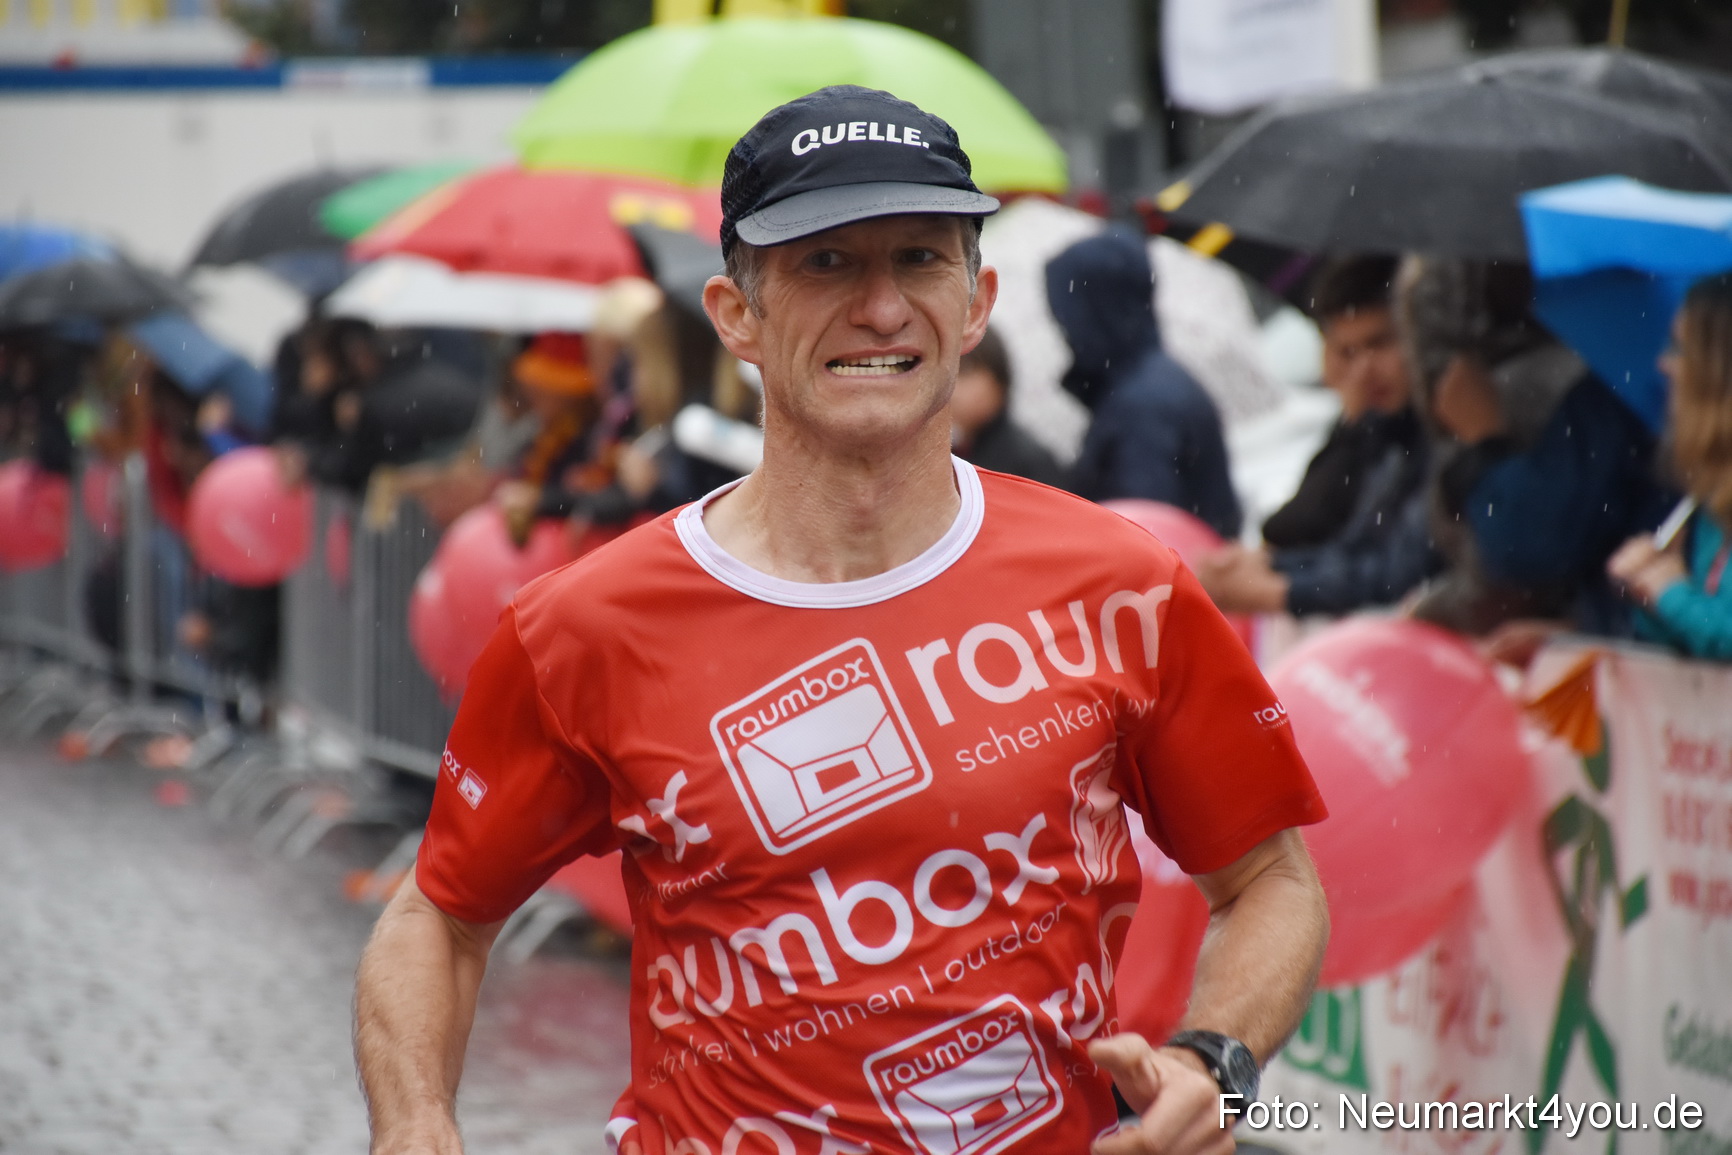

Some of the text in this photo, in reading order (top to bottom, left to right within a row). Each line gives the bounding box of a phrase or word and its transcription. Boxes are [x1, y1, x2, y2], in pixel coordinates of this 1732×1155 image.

[791, 121, 930, 156] QUELLE.
[725, 657, 870, 747] raumbox
[955, 697, 1111, 772] schenken
[764, 984, 915, 1052] wohnen
[945, 902, 1068, 982] outdoor
[880, 1011, 1019, 1092] raumbox
